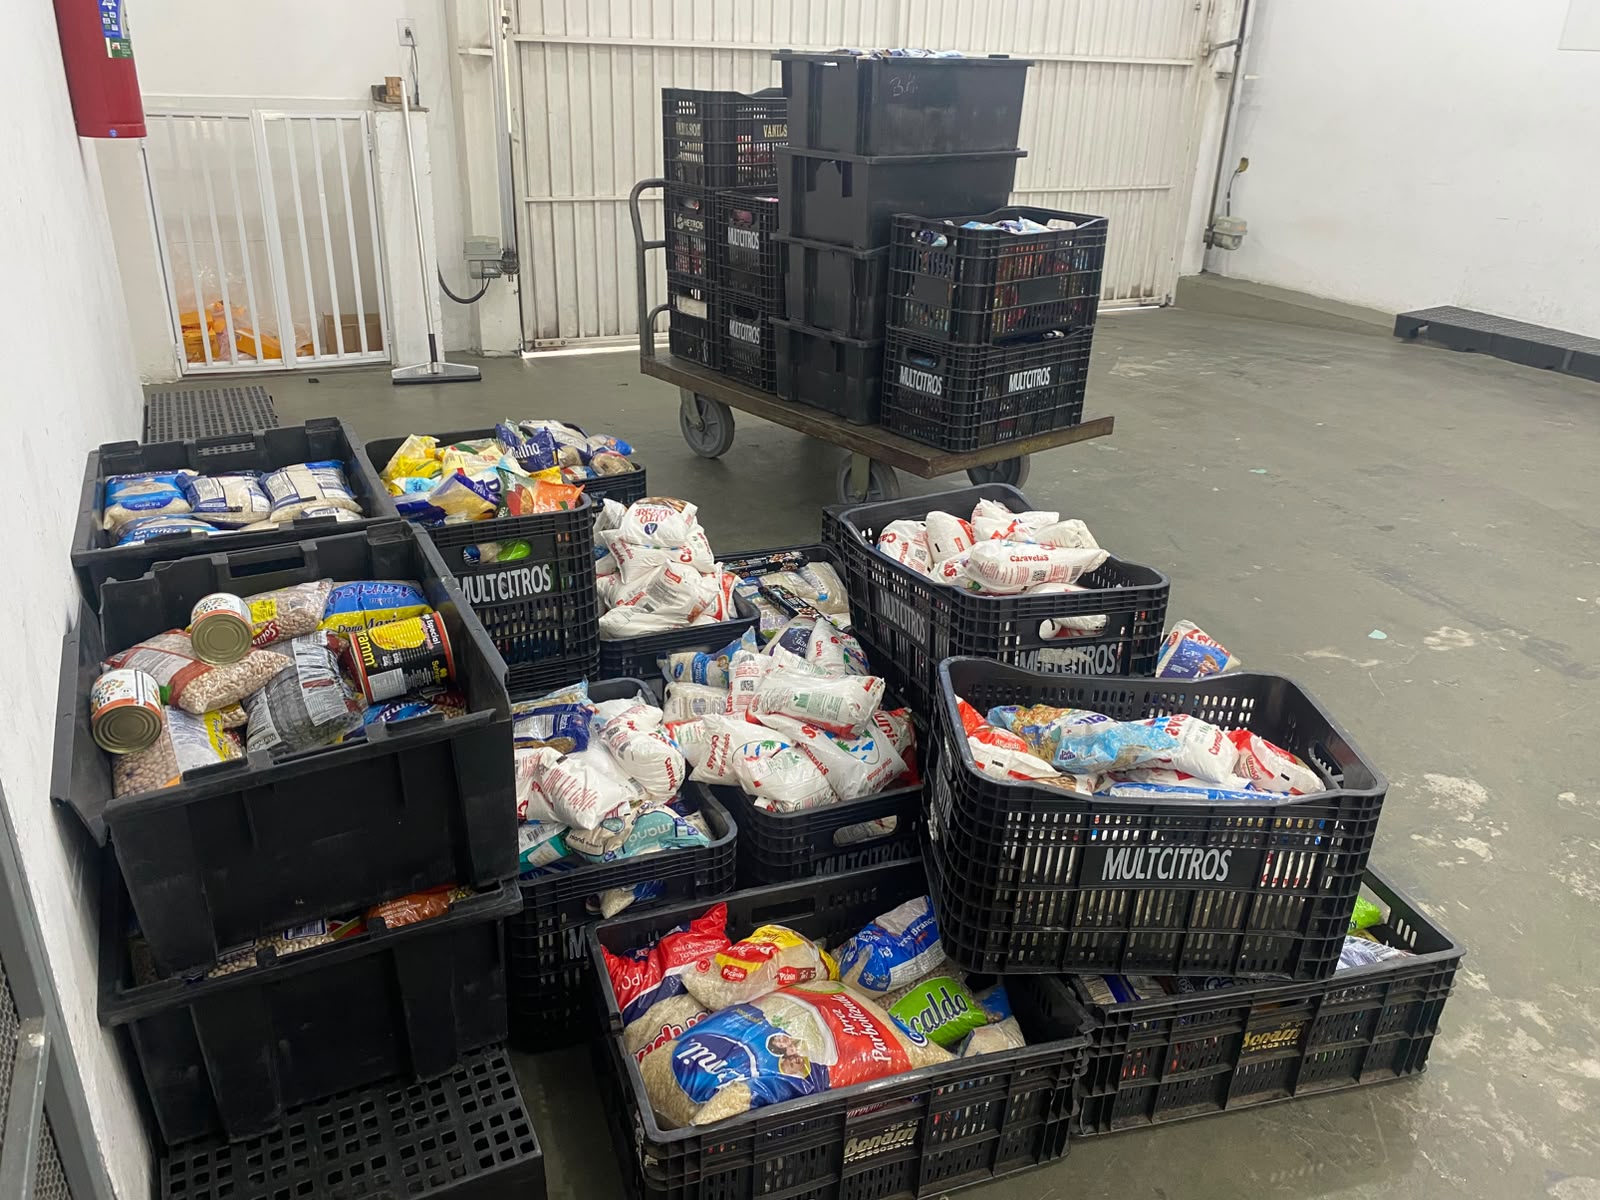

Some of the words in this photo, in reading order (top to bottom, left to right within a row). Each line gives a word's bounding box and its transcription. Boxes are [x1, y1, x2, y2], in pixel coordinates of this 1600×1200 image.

[763, 124, 787, 138] VANILS
[727, 226, 760, 250] MULTCITROS
[729, 319, 760, 344] MULTCITROS
[900, 365, 943, 395] MULTCITROS
[1008, 366, 1051, 393] MULTCITROS
[367, 614, 403, 629] Mari
[357, 629, 378, 667] ramm
[1101, 847, 1232, 881] MULTCITROS
[909, 986, 969, 1036] caldo
